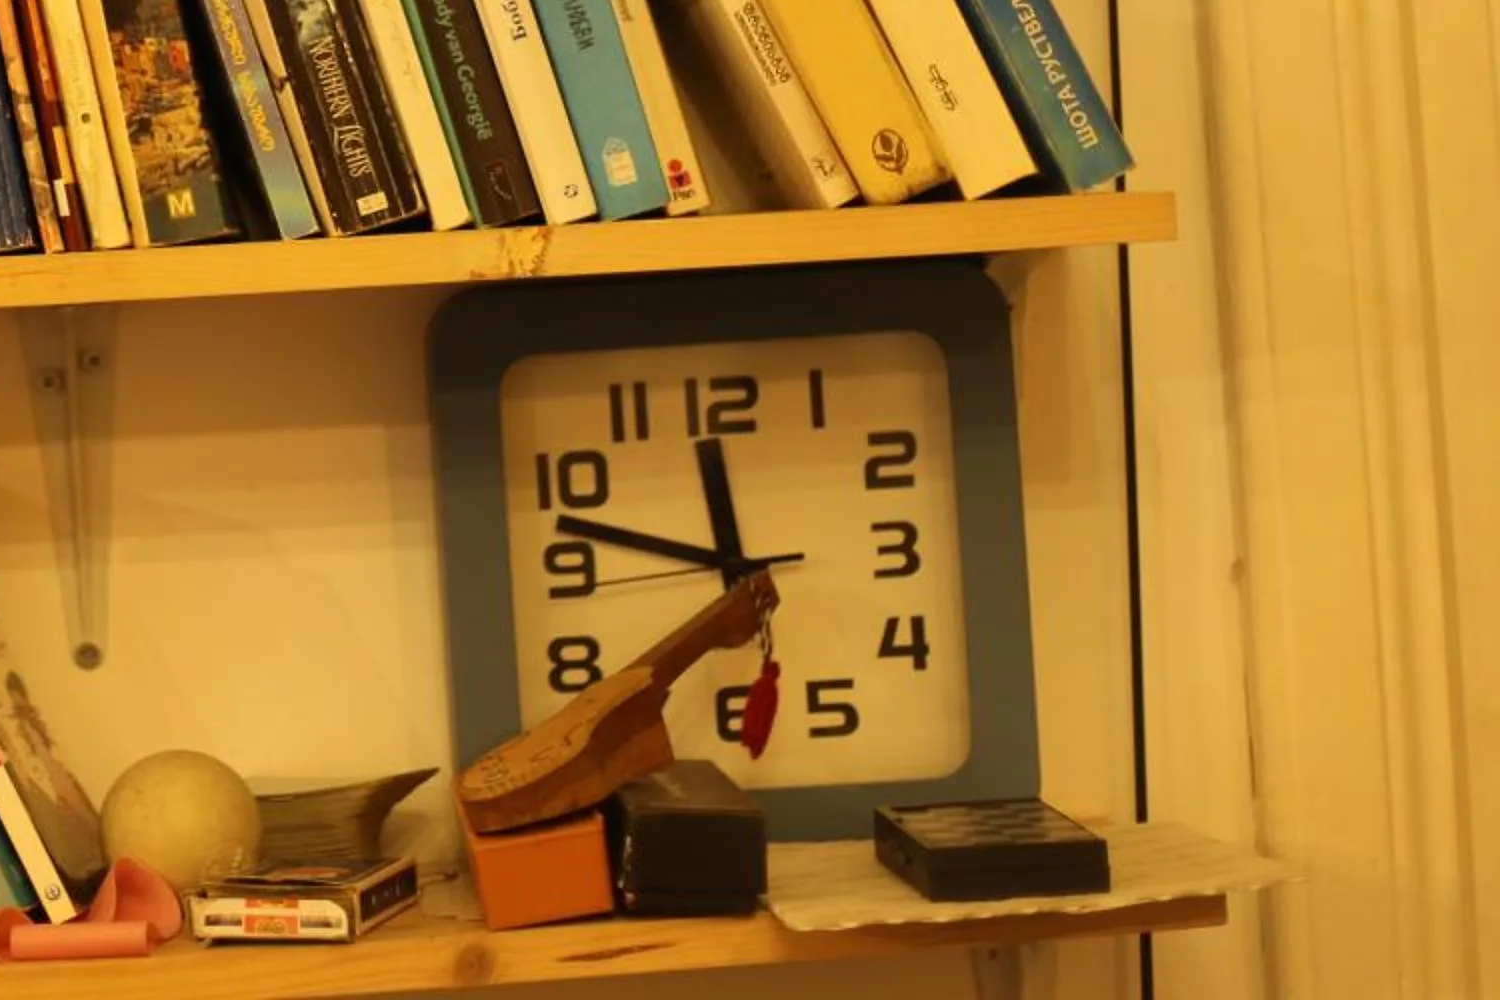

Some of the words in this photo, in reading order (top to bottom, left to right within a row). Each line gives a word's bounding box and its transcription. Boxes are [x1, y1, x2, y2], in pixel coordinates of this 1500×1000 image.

[306, 33, 355, 119] NORTHERN
[443, 28, 465, 64] van
[451, 62, 495, 142] Georgië
[1053, 81, 1099, 151] ШОТА
[325, 112, 378, 181] LIGHTS
[609, 381, 649, 443] 11
[684, 375, 758, 438] 12
[807, 368, 826, 430] 1
[536, 449, 609, 511] 10
[864, 430, 916, 490] 2
[544, 540, 597, 599] 9
[872, 520, 921, 579] 3
[548, 635, 603, 692] 8
[878, 615, 930, 671] 4
[806, 679, 860, 739] 5
